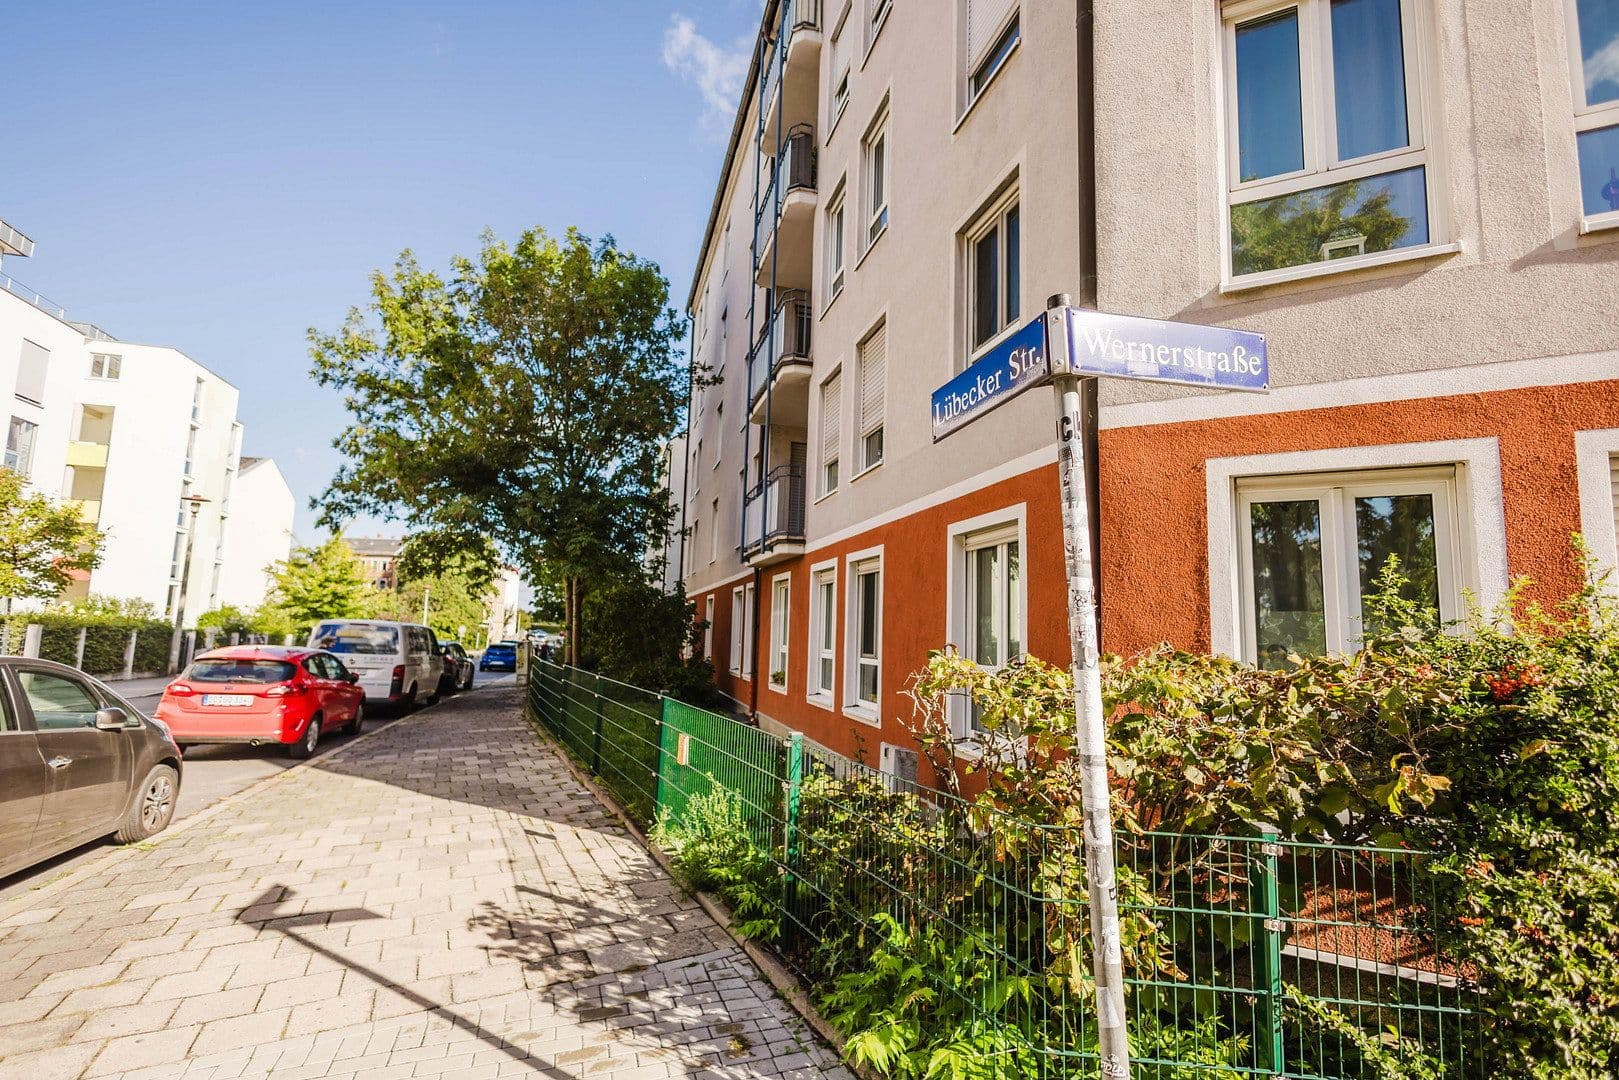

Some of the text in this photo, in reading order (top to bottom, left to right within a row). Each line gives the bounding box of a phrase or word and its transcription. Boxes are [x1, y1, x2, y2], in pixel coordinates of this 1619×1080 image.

[1083, 328, 1263, 376] Wernerstraße
[934, 346, 1041, 426] Lübecker Str.
